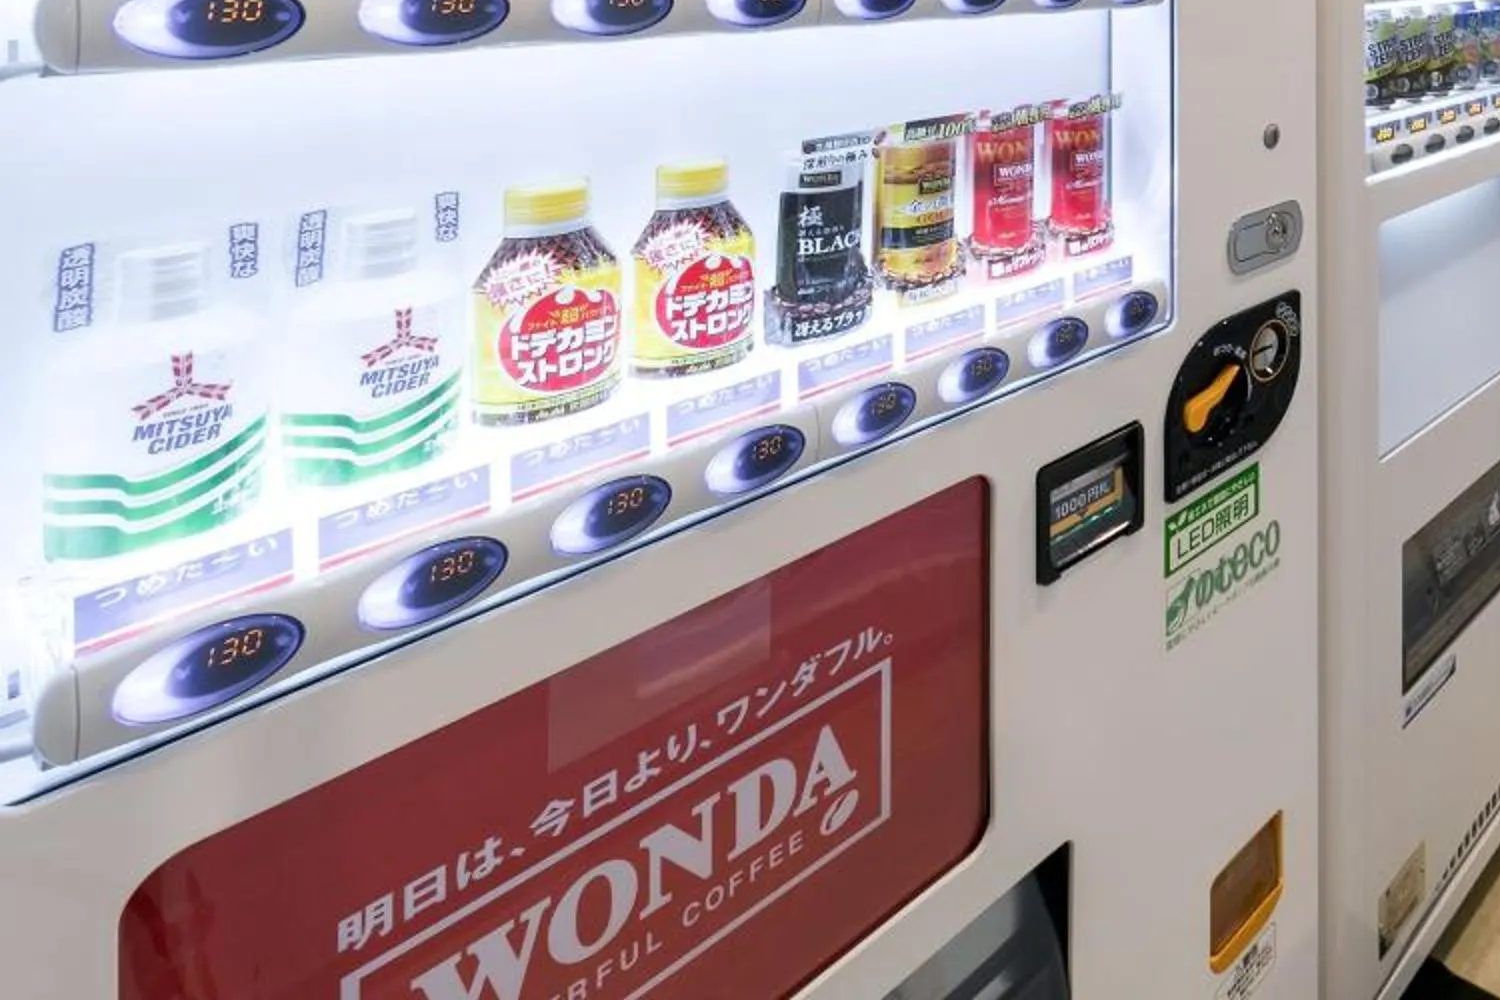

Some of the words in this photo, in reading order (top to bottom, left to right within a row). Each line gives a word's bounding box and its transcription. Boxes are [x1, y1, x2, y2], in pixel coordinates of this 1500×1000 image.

[798, 230, 862, 255] BLAC
[360, 355, 441, 387] MITSUYA
[518, 341, 615, 385] ストロング
[371, 373, 430, 399] CIDER
[132, 403, 233, 442] MITSUYA
[148, 424, 222, 455] CIDER
[751, 435, 783, 460] 130
[334, 471, 481, 528] つめた〜い
[606, 487, 644, 515] 130
[1177, 492, 1250, 560] LED照明
[92, 536, 279, 607] つめた〜い
[430, 549, 474, 582] 130
[207, 629, 263, 666] 130
[337, 626, 893, 953] 明日は、今日より、ワンダフル。
[411, 725, 857, 1000] WONDA
[553, 931, 664, 1000] RFUL
[682, 833, 803, 927] COFFEE
